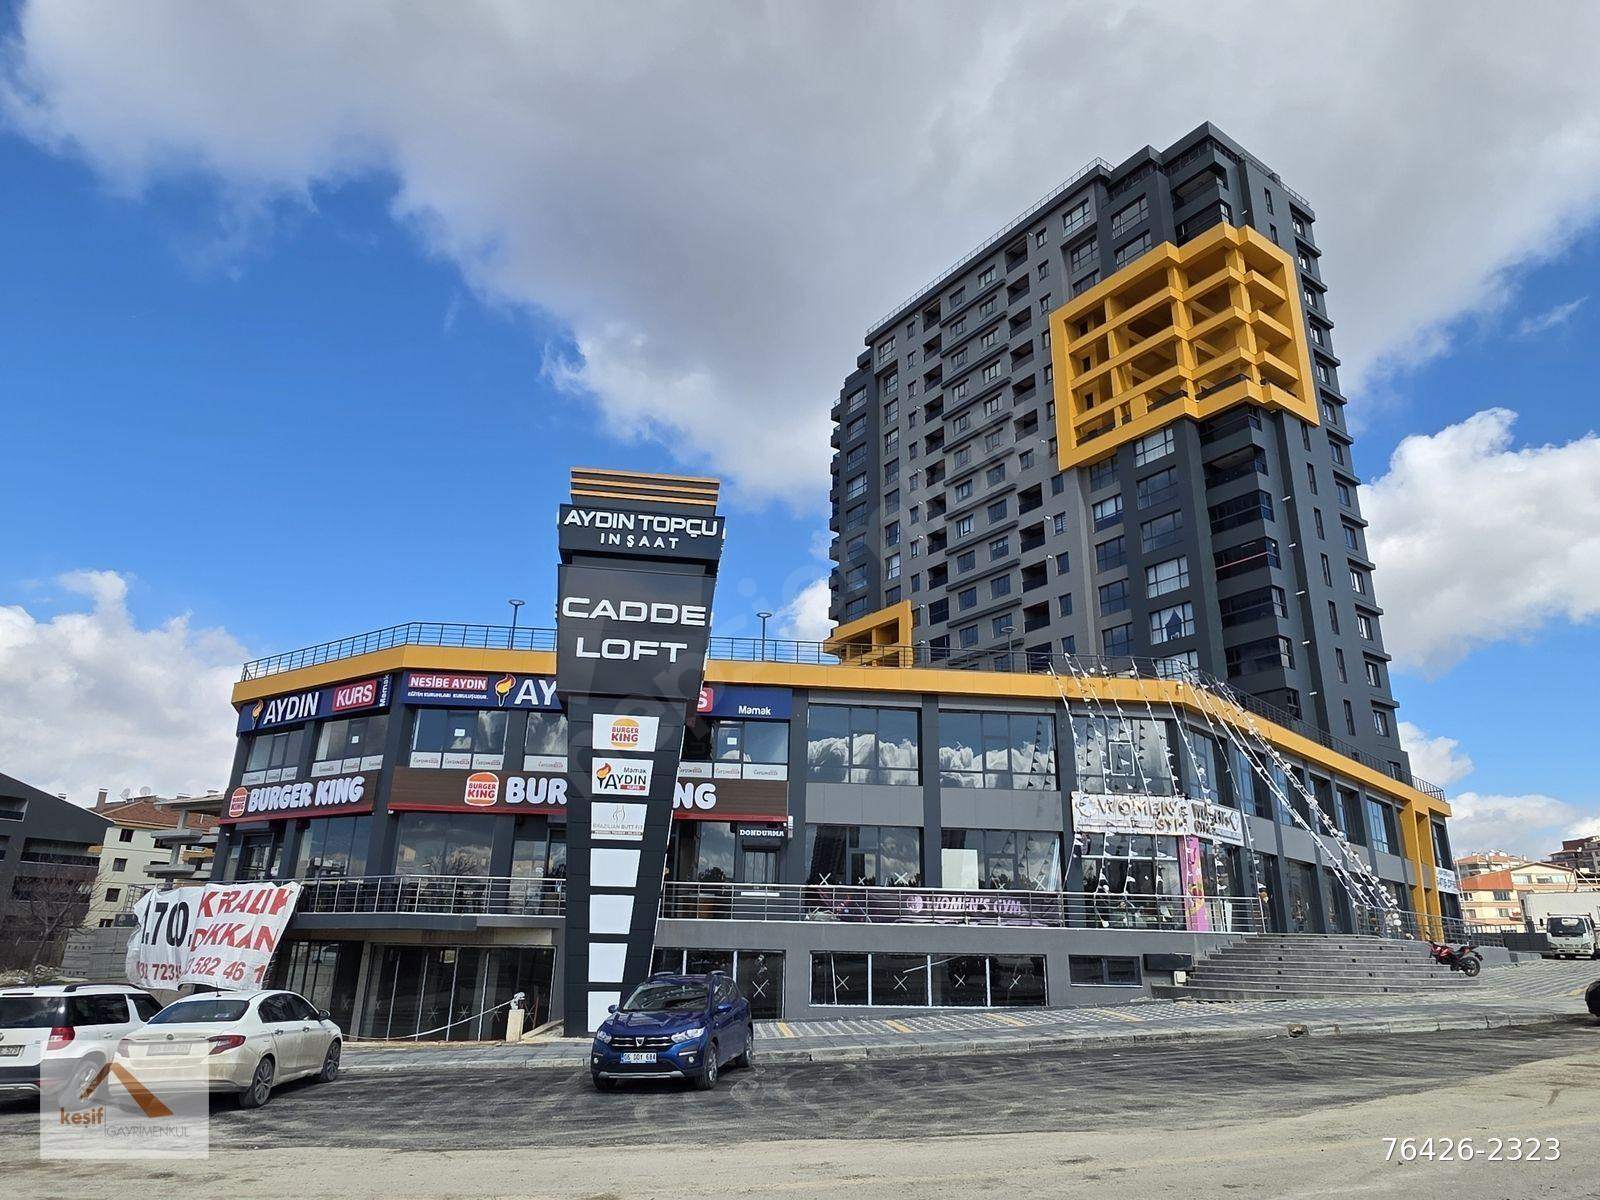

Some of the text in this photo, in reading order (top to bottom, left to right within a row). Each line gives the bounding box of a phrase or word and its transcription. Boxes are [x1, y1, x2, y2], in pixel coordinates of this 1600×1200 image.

[563, 509, 718, 537] AYDIN TOPÇU
[562, 596, 707, 626] CADDE
[576, 637, 688, 663] LOFT
[378, 674, 390, 707] Mamak
[410, 675, 487, 690] NESİBE AYDIN
[514, 679, 557, 705] AY
[263, 691, 320, 725] AYDIN
[336, 684, 374, 708] KURS
[738, 705, 772, 715] Mamak
[611, 733, 638, 742] KING
[248, 776, 365, 812] BURGER KING
[467, 789, 496, 799] KING
[505, 776, 717, 810] BUR NG
[604, 774, 647, 790] AYDIN
[739, 829, 785, 837] DONDURMA
[223, 961, 246, 981] 46
